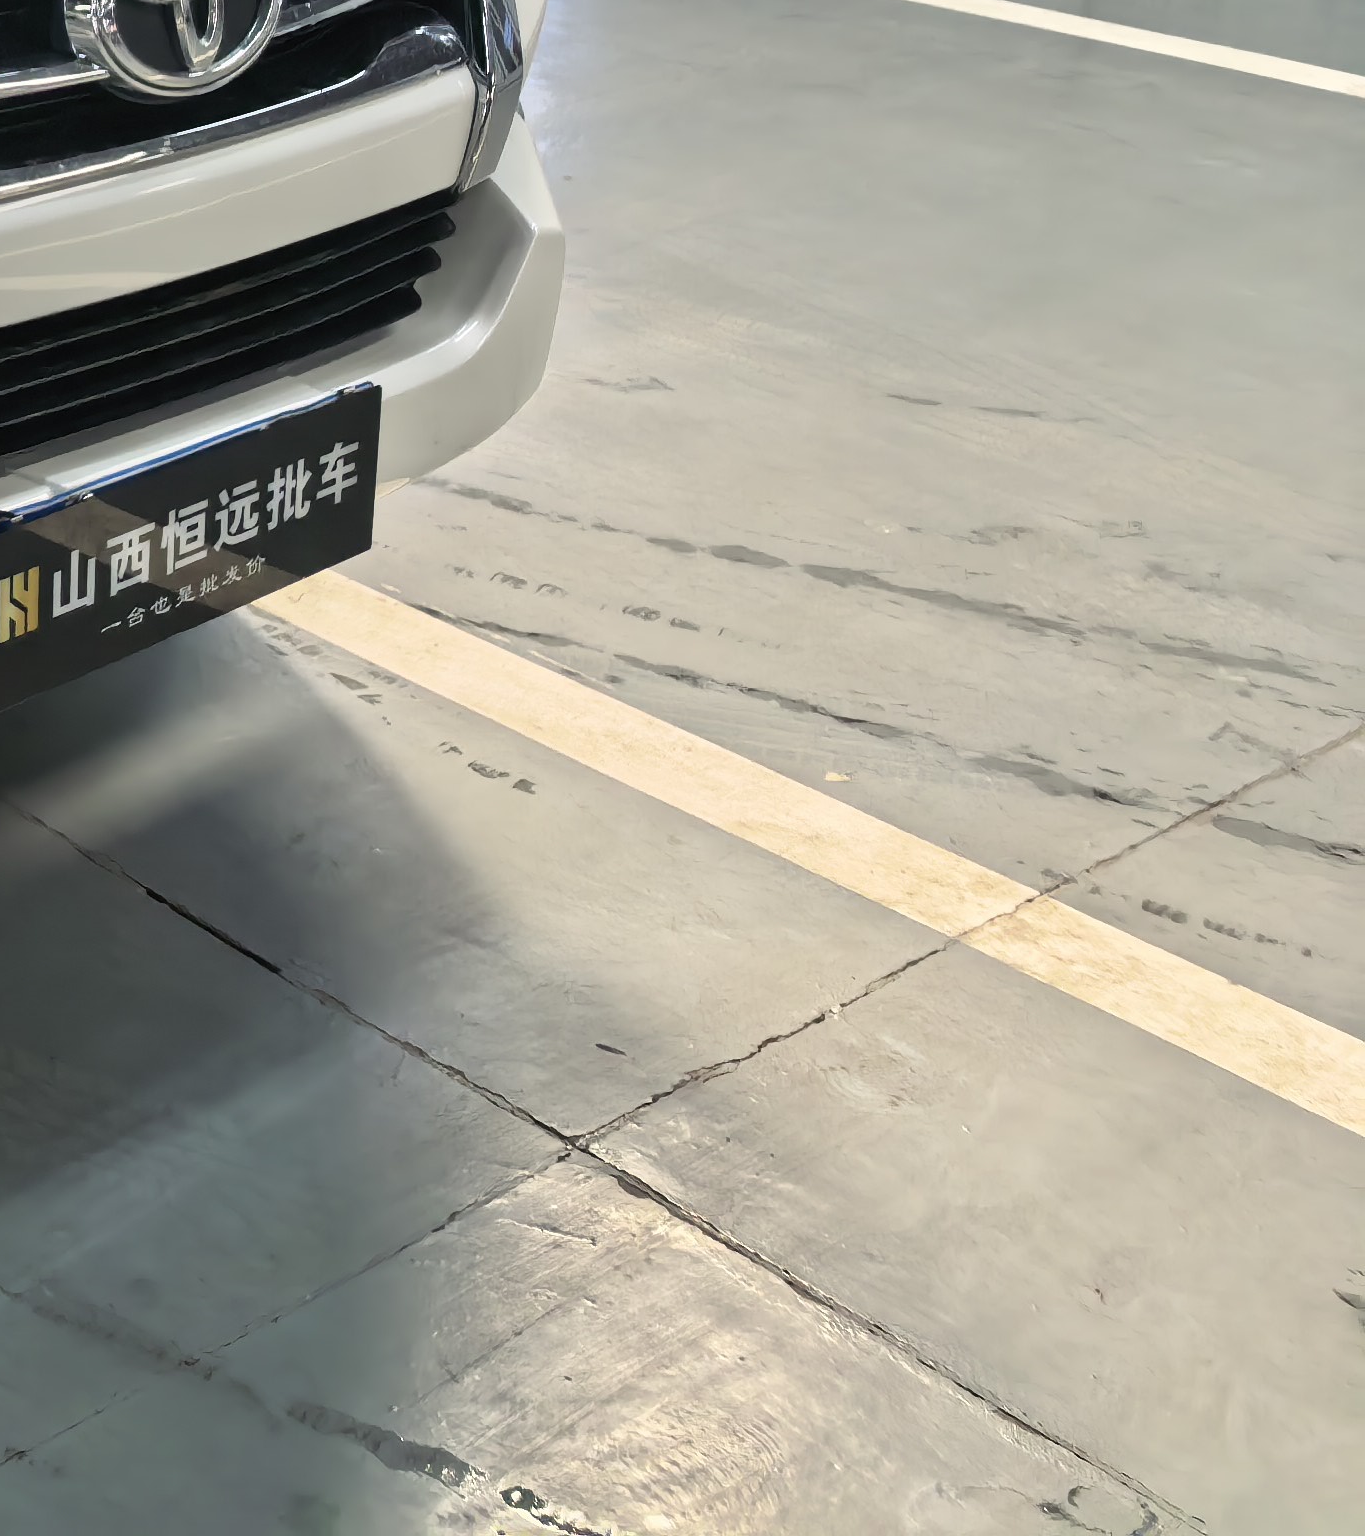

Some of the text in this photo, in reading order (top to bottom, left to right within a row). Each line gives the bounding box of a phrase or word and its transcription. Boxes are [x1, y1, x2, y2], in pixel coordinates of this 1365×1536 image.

[52, 441, 360, 619] 山西恒远批车
[101, 554, 267, 633] 一台也是批发价
